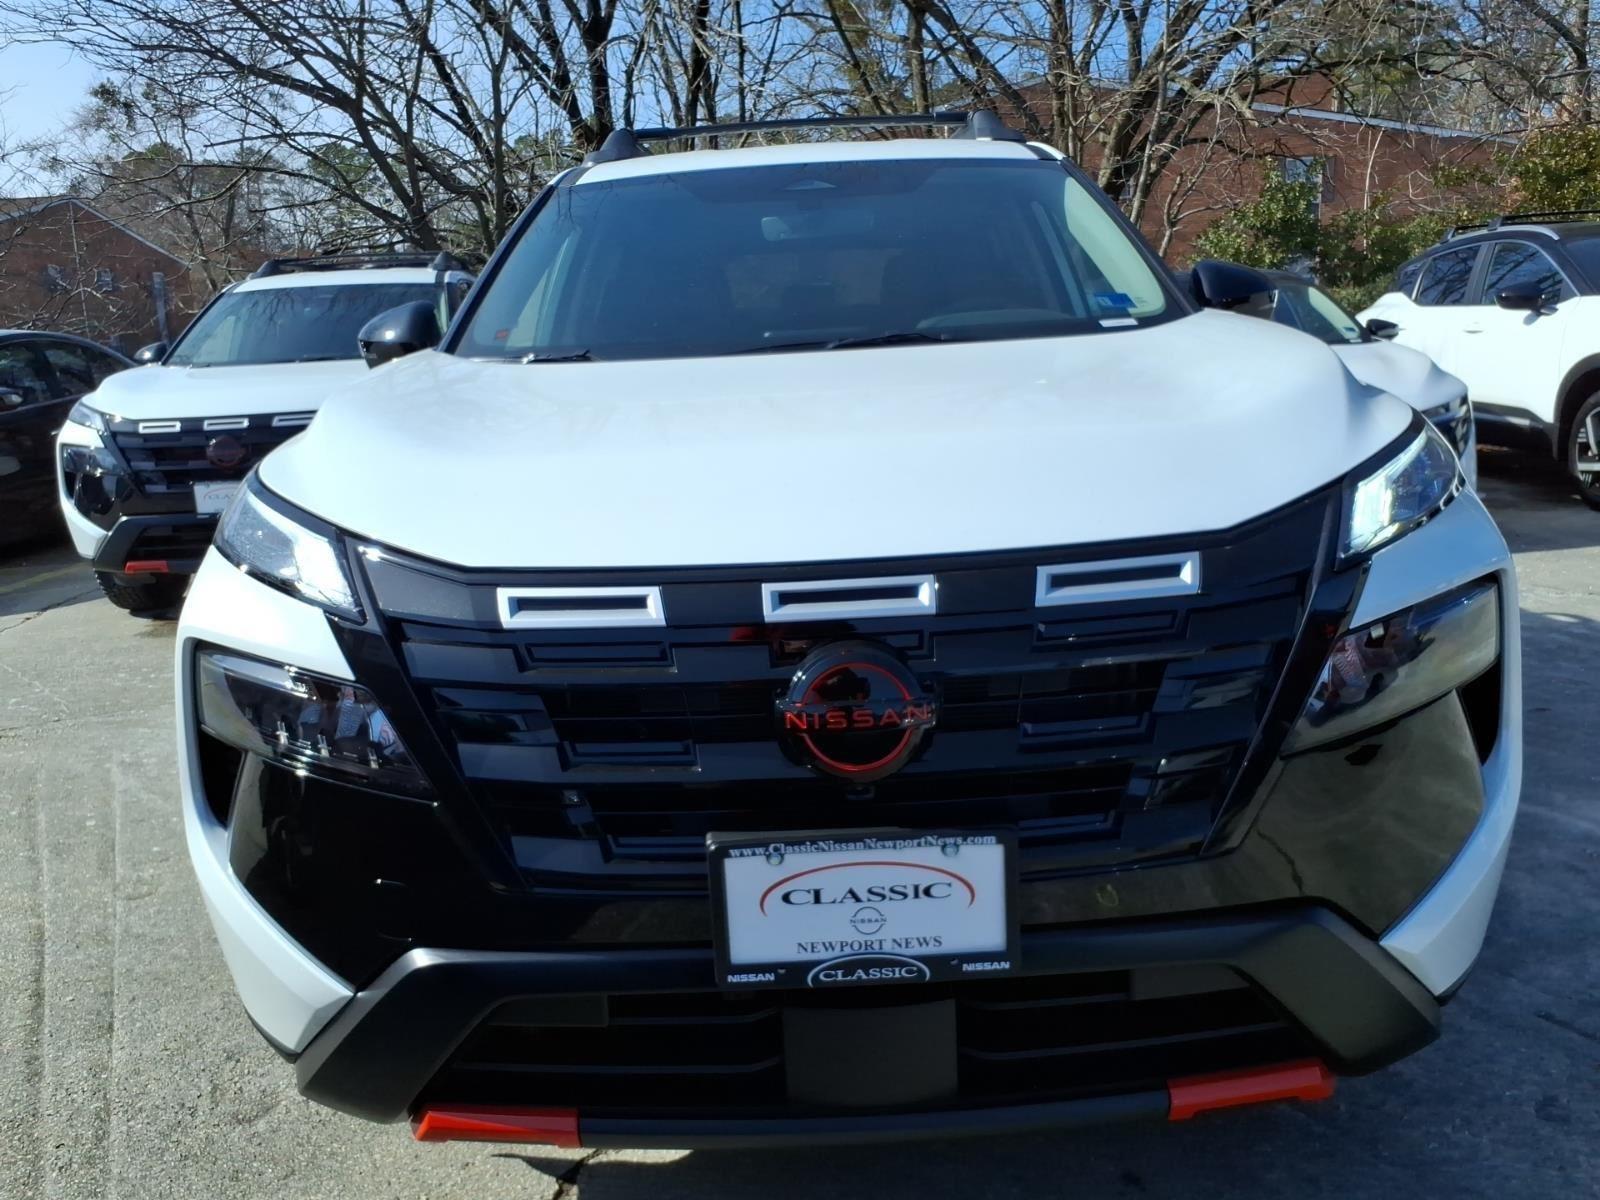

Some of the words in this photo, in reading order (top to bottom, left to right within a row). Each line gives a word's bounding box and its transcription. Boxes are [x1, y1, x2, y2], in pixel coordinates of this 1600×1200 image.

[784, 706, 929, 729] NISSAN
[728, 834, 997, 857] www.ClassicNissanNewportNews.com
[781, 882, 953, 905] CLASSIC
[849, 916, 887, 925] NISSAN
[796, 938, 887, 954] NEWPORT
[891, 935, 943, 951] NEWS
[818, 966, 918, 982] CLASSIC
[962, 961, 1011, 972] NISSAN
[727, 972, 775, 983] NISSAN
